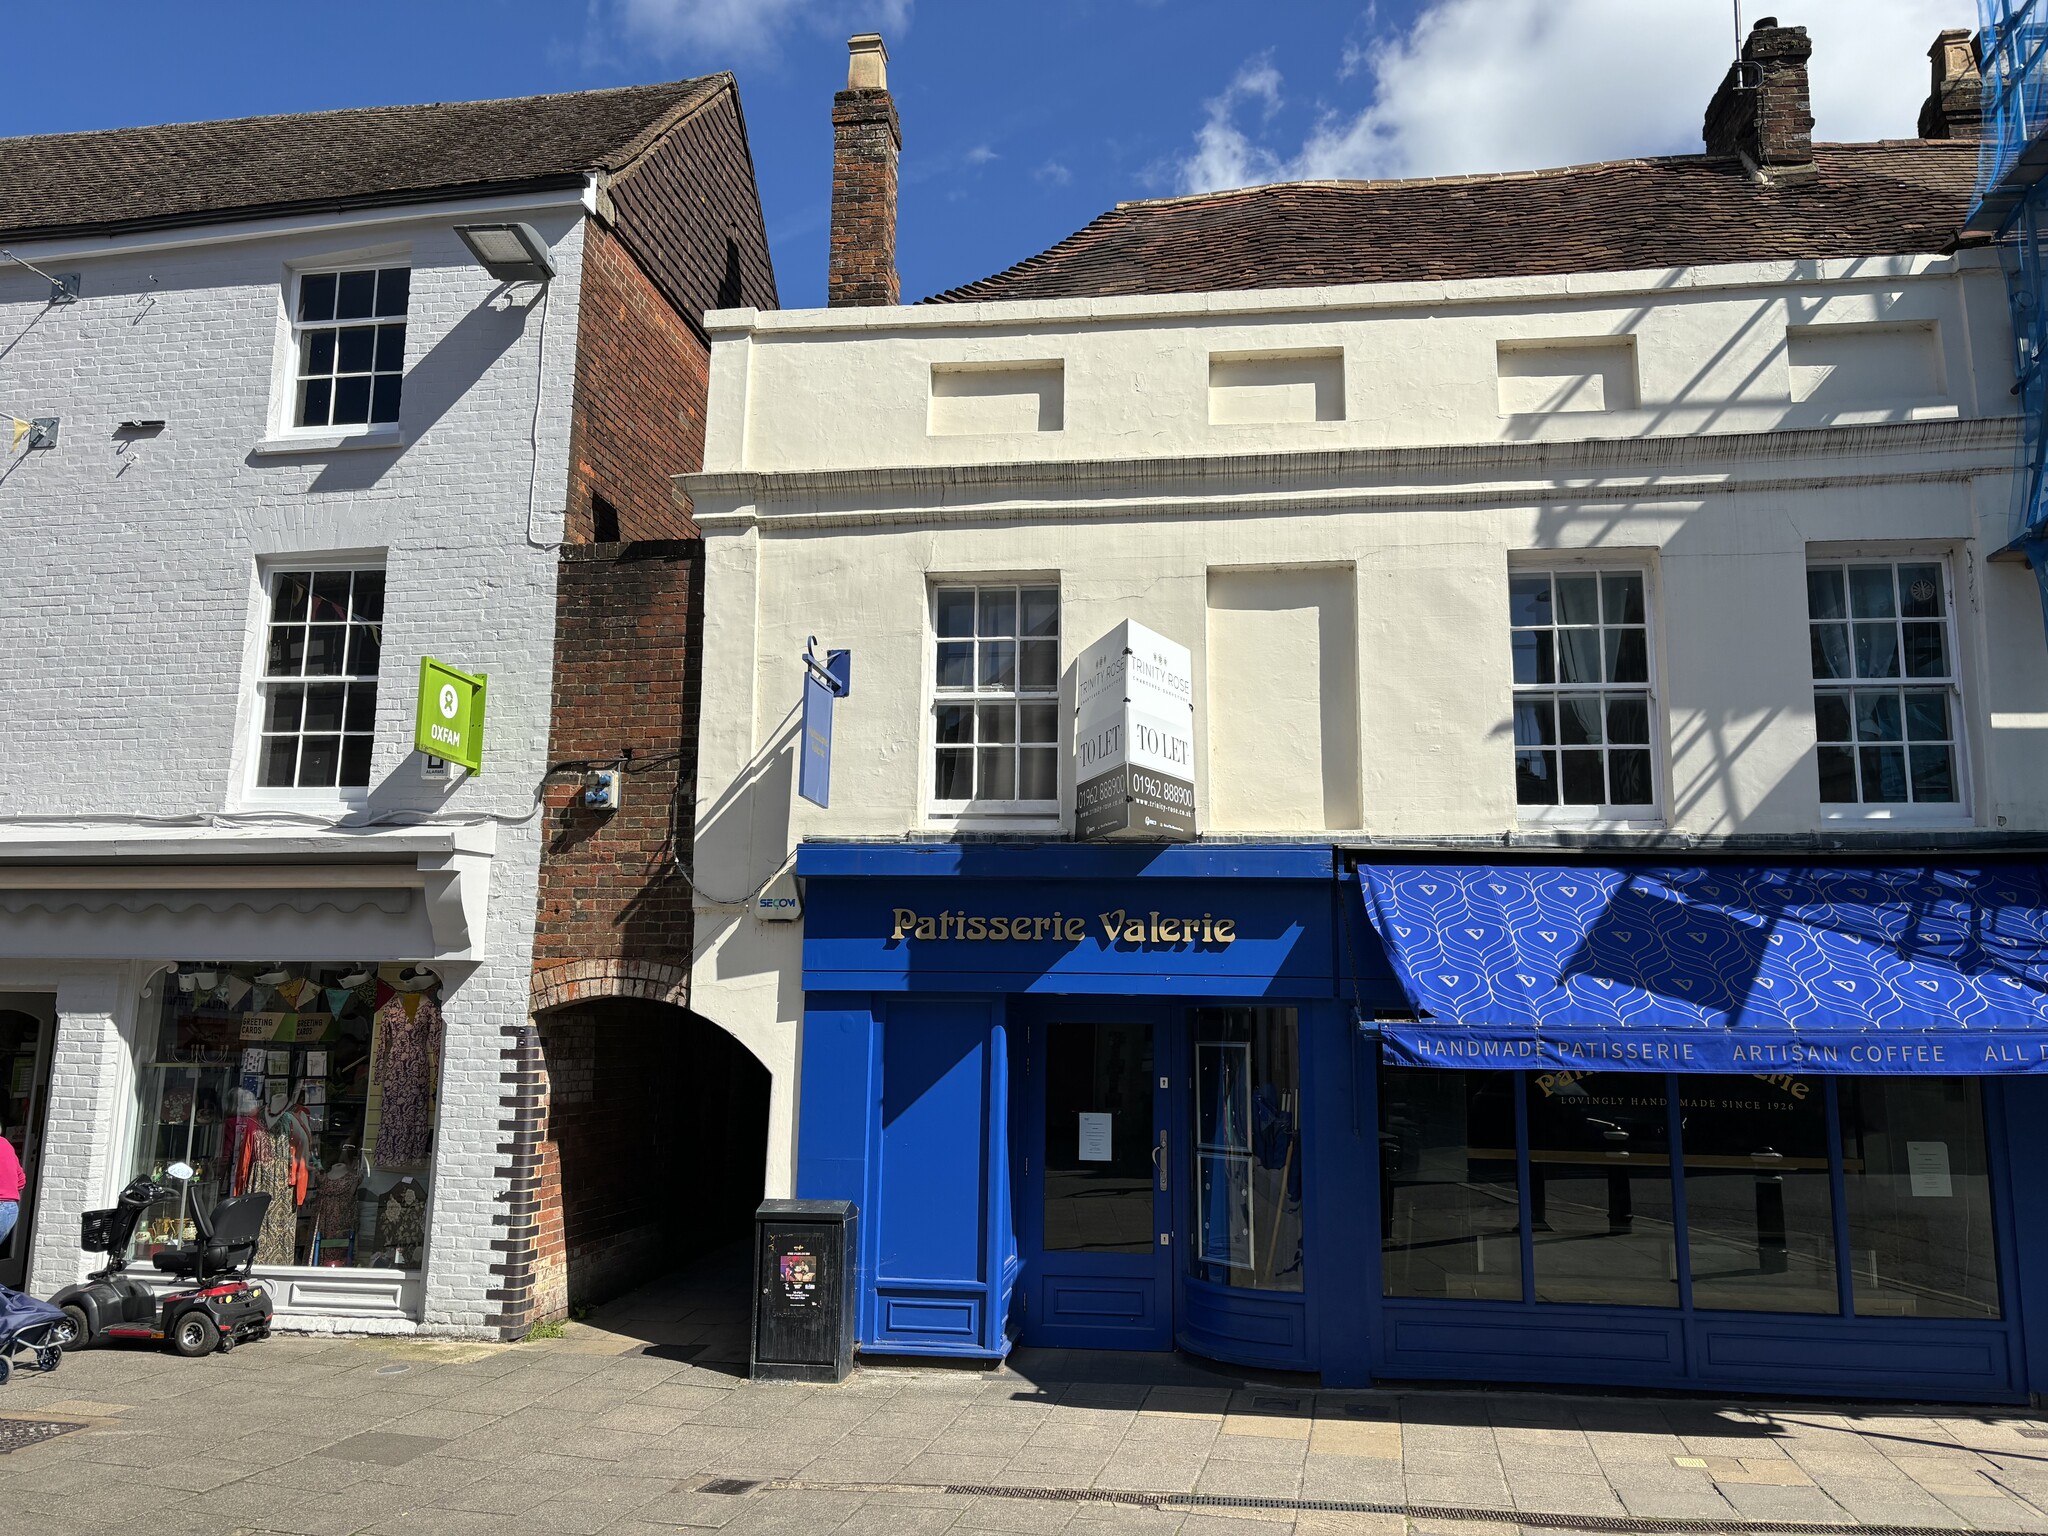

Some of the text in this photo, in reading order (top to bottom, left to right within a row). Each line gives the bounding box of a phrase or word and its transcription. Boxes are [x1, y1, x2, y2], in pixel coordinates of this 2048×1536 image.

[1080, 656, 1125, 696] TRINITY ROSE
[1131, 655, 1189, 694] TRINITY ROSE
[431, 723, 460, 747] OXFAM
[1136, 724, 1188, 765] TO LET
[1080, 724, 1120, 767] TO LET
[1078, 774, 1125, 808] 01962 888900
[1132, 773, 1193, 807] 01962 888900
[1135, 797, 1192, 818] www.trinity-rose.co.uk
[760, 898, 796, 907] SECOM
[891, 908, 1236, 943] Patisserie Valerie
[241, 1026, 262, 1034] CARDS
[242, 1018, 272, 1026] GREETING
[296, 1027, 312, 1035] CARDS
[297, 1019, 322, 1027] GREETING
[1418, 1040, 1694, 1060] HANDMADE PATISSERIE
[1733, 1045, 1945, 1062] ARTISAN COFFEE
[1985, 1045, 2029, 1062] ALL
[1561, 1096, 1794, 1111] LOVINGLY HAND MADE SINCE 1926
